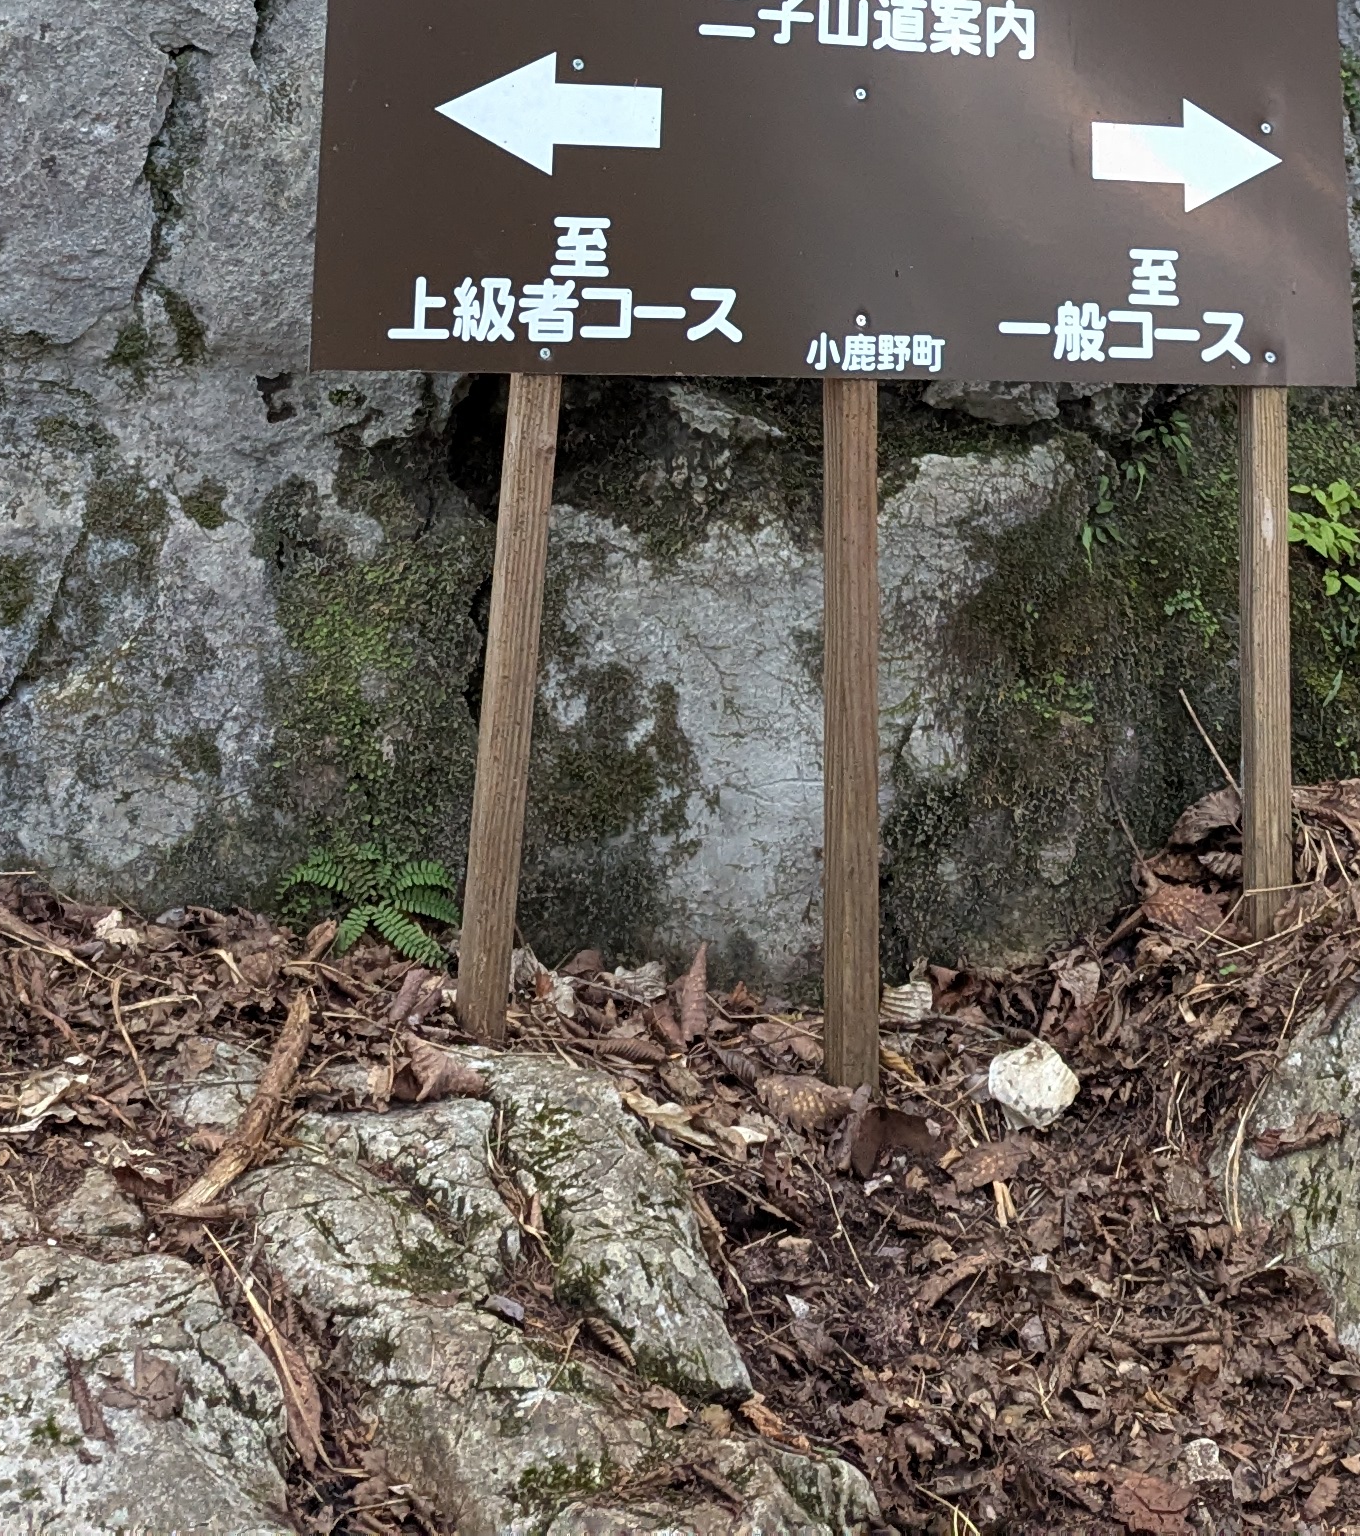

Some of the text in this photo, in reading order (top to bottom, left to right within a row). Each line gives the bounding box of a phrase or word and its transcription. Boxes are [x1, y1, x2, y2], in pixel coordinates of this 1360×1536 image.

[550, 216, 611, 279] 至
[1128, 249, 1180, 307] 至
[387, 277, 743, 344] 上級者コース
[997, 301, 1251, 365] 一般コース
[805, 333, 946, 374] 小鹿野町
